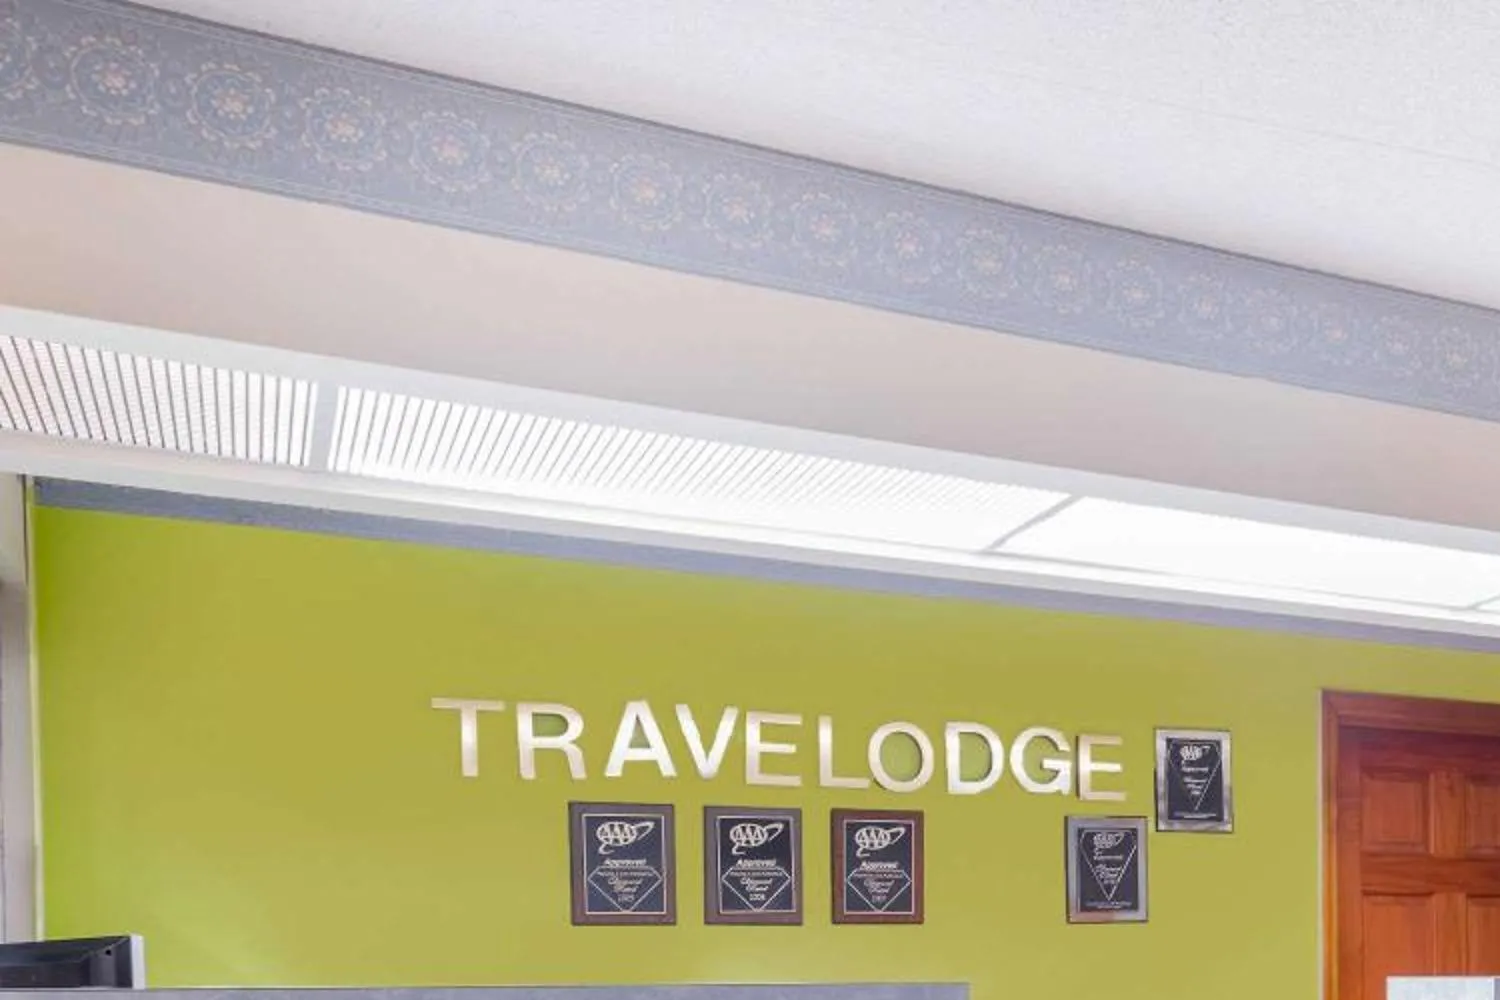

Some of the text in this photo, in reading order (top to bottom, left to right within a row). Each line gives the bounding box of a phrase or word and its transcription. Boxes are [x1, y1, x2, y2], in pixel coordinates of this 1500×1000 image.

[431, 698, 1126, 800] TRAVELODGE
[597, 821, 637, 846] AAA
[730, 823, 768, 847] AAA
[856, 826, 890, 850] AAA
